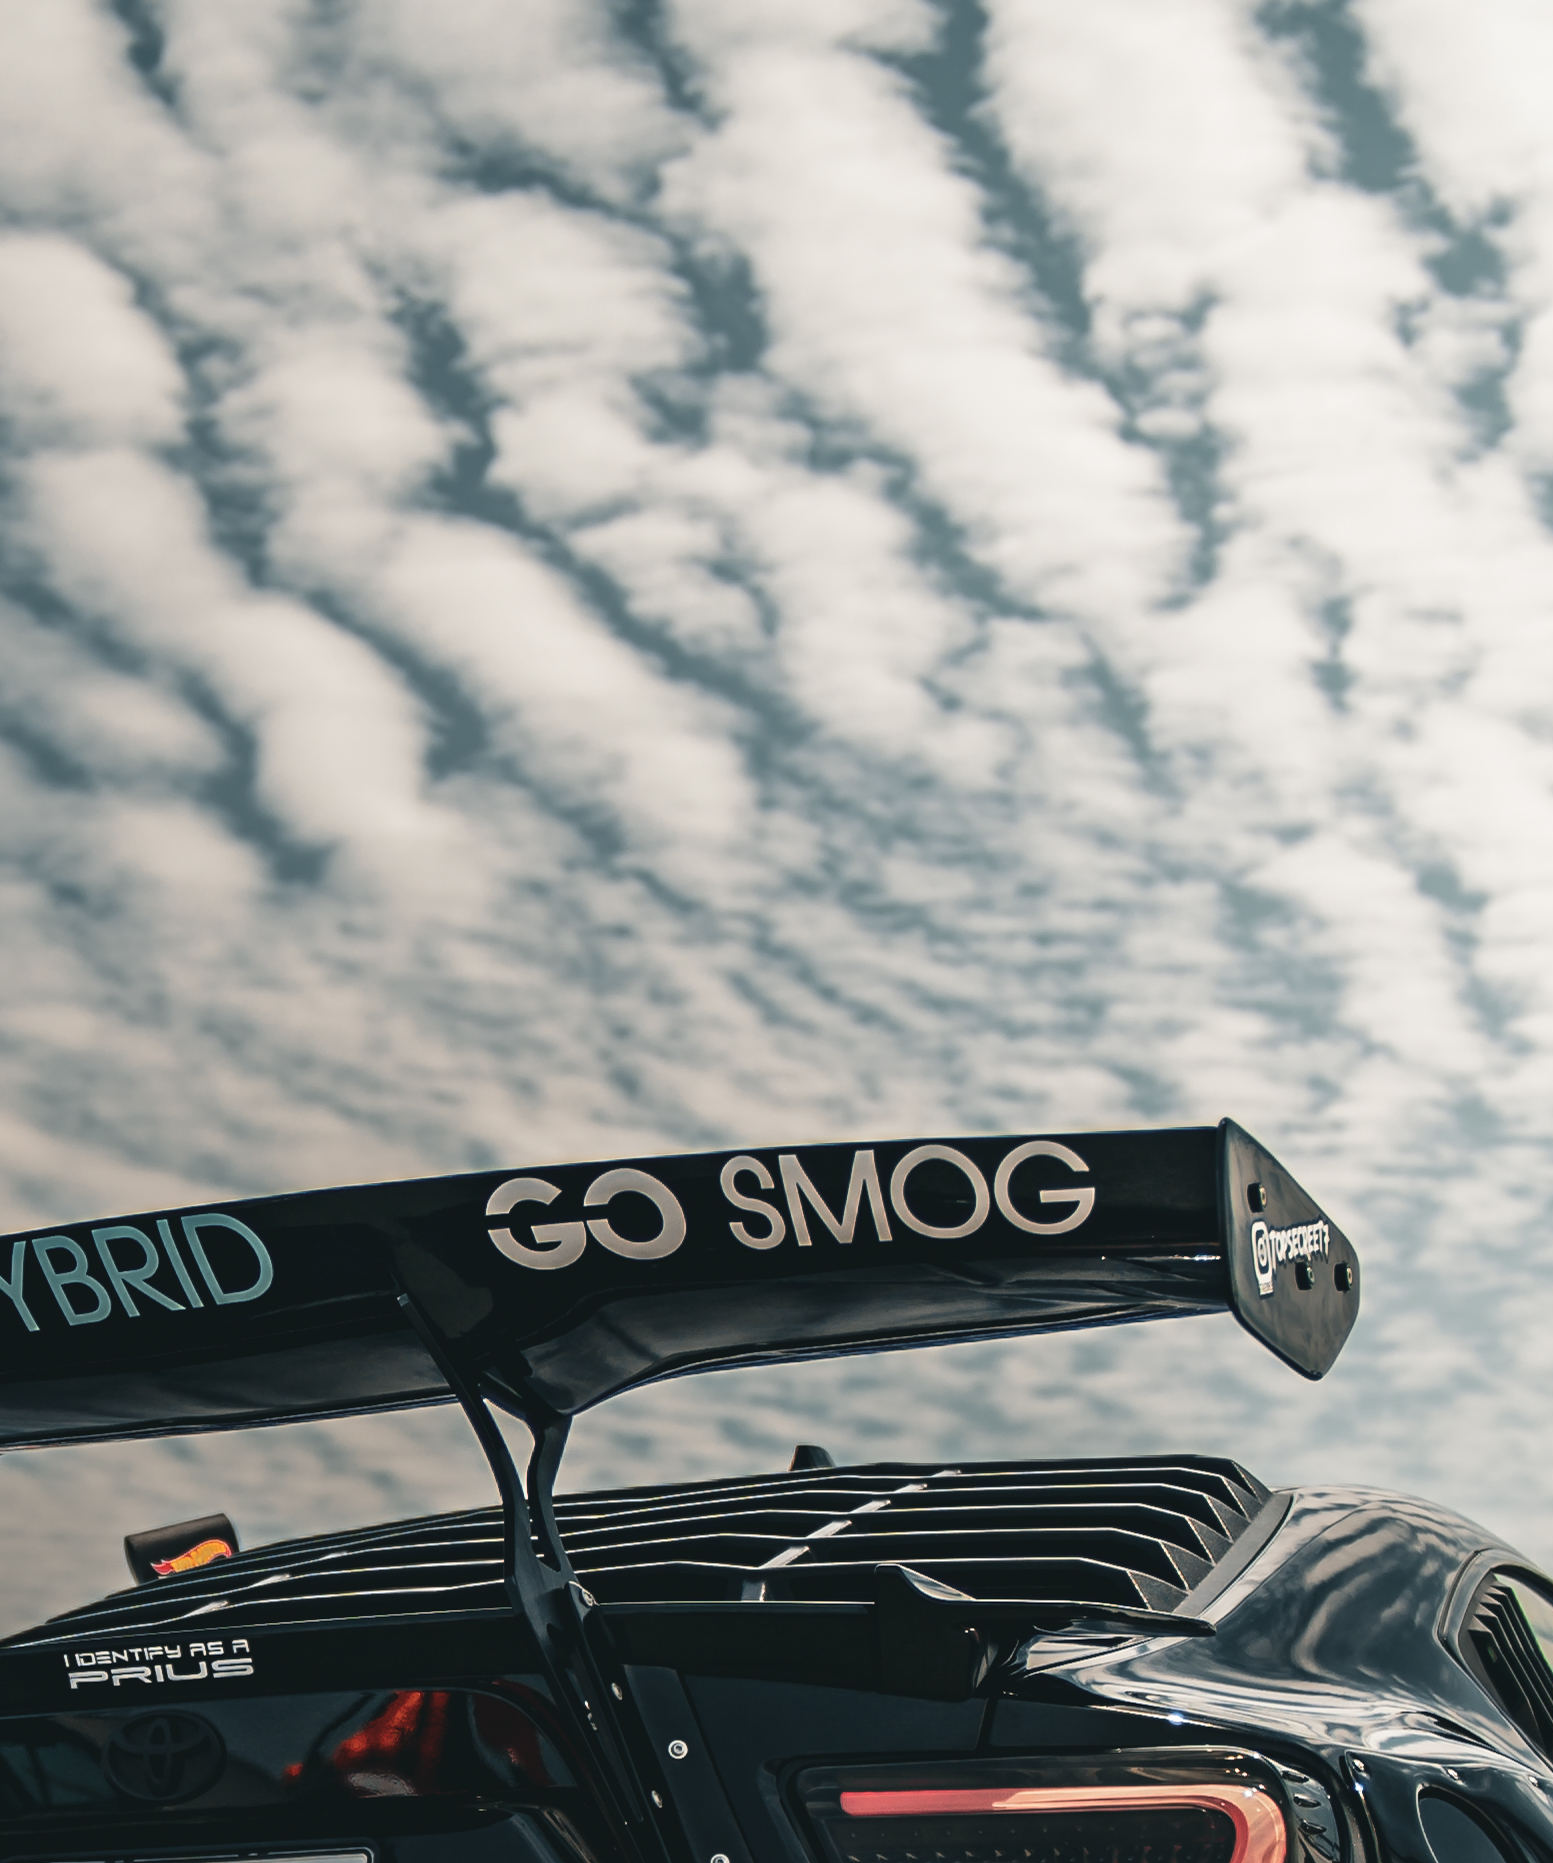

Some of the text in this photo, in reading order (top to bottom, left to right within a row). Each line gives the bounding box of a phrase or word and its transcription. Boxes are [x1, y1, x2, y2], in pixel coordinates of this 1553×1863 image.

[485, 1168, 686, 1271] GO
[720, 1140, 1096, 1249] SMOG
[63, 1639, 250, 1667] I IDENTIFY AS A
[68, 1657, 254, 1689] PRIUS
